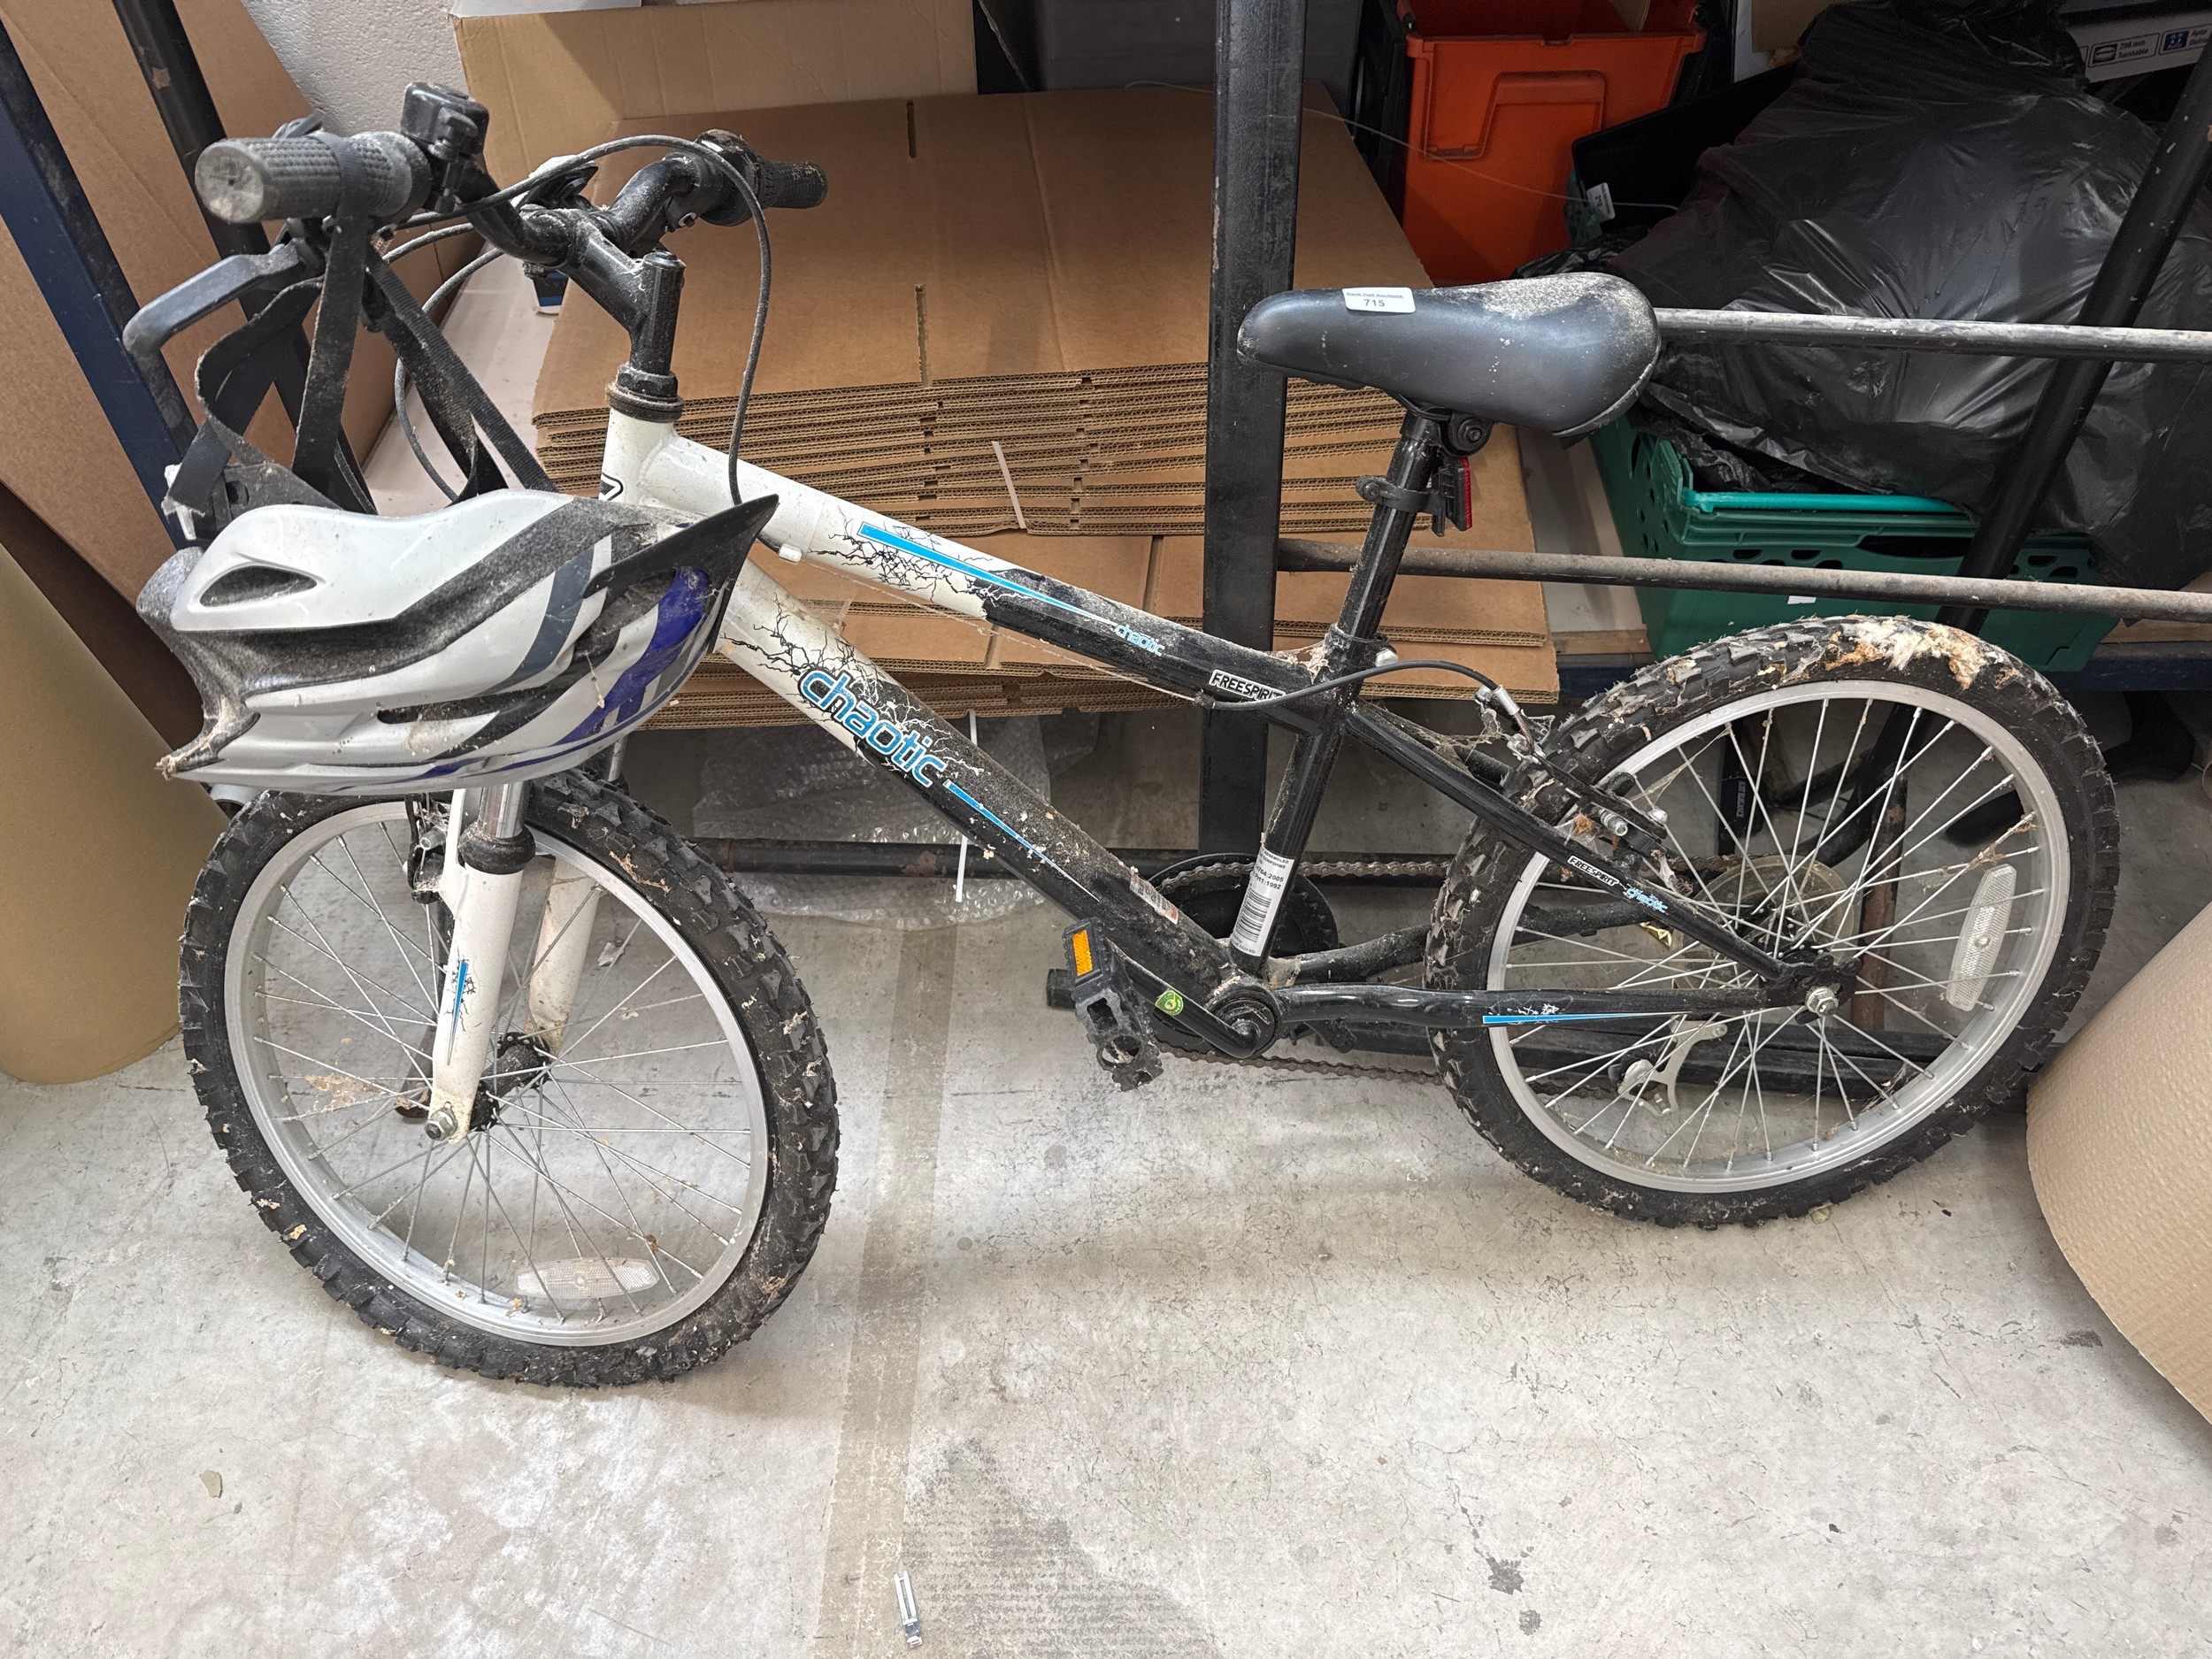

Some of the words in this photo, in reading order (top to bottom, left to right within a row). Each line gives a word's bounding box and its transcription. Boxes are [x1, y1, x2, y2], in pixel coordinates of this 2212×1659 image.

[2118, 48, 2149, 58] Turntable
[1363, 298, 1386, 307] 715
[1114, 624, 1165, 657] chaotic
[799, 669, 948, 787] chaotic
[1569, 856, 1618, 886] FREESPIRIT
